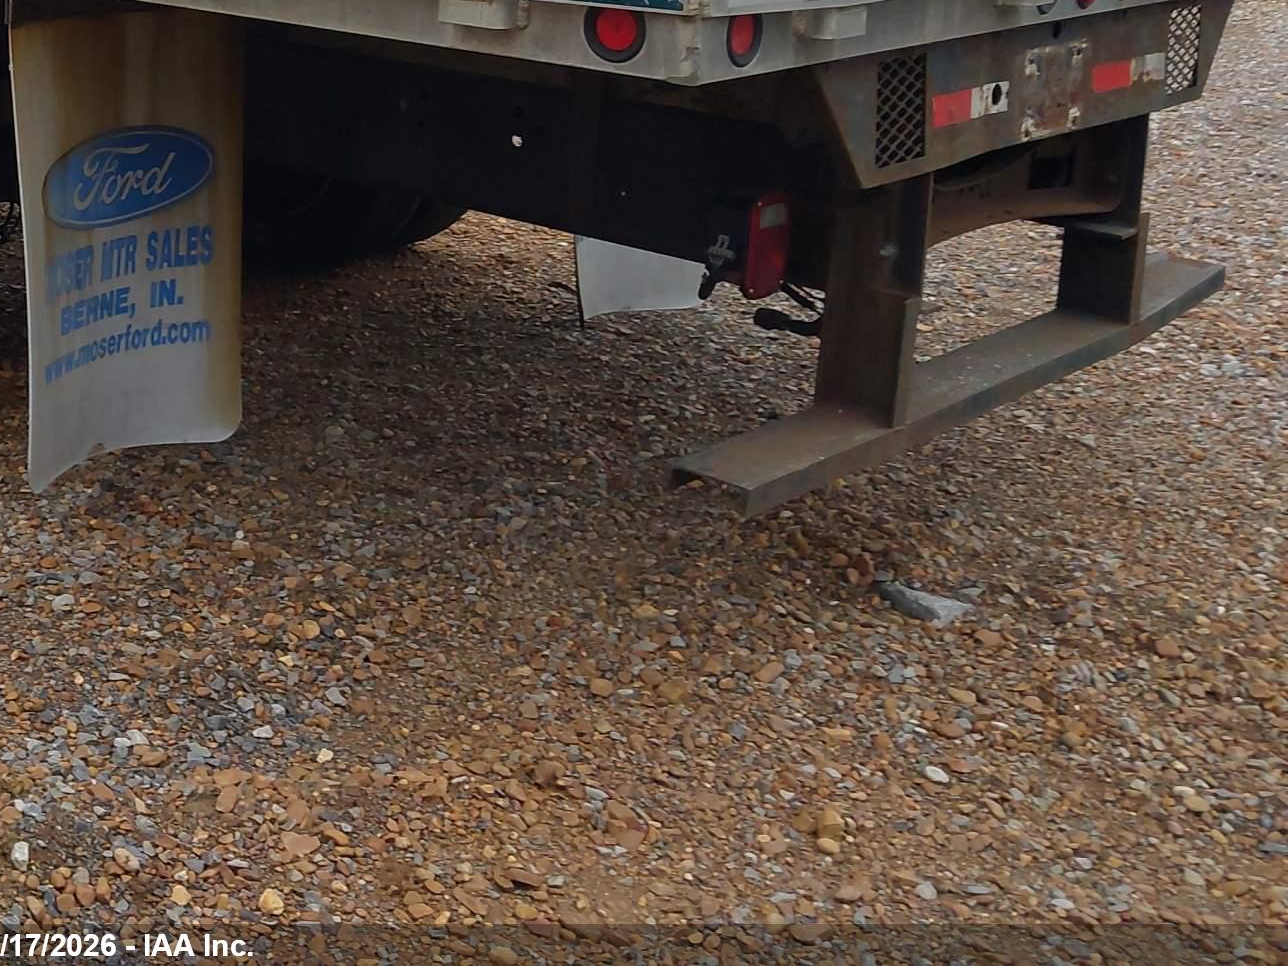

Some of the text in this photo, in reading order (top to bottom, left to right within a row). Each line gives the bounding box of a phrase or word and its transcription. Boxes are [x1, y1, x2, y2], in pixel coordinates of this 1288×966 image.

[73, 143, 176, 211] Ford
[146, 225, 215, 271] SALES
[60, 279, 184, 336] BERNE, IN.
[45, 320, 210, 385] www.moserford.com
